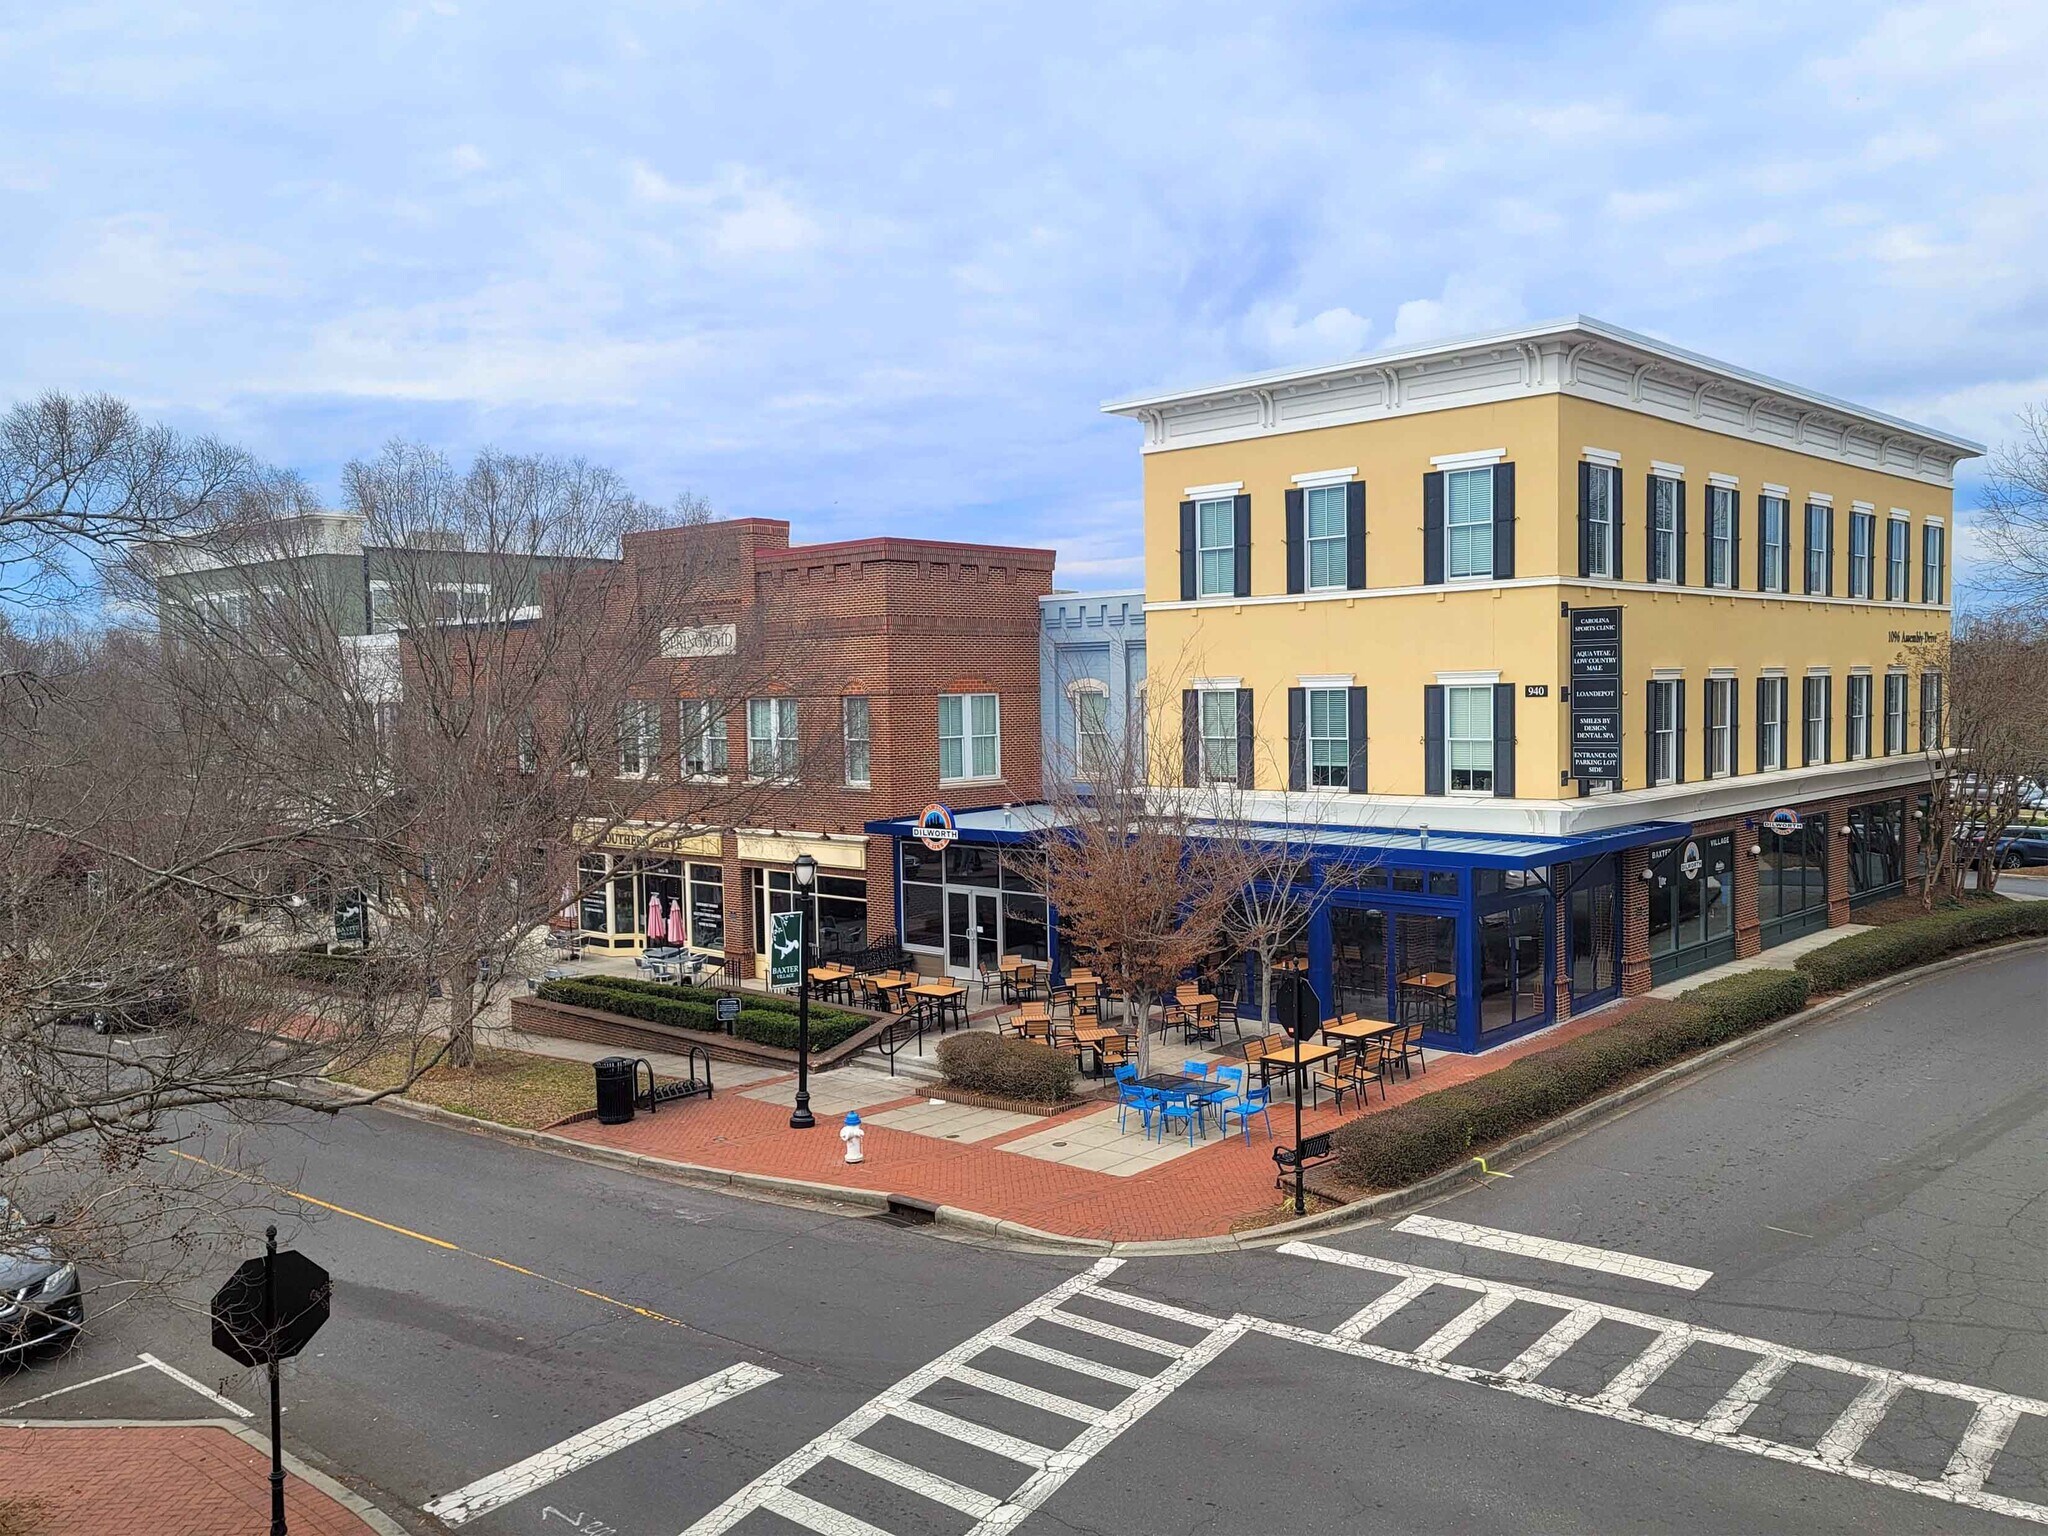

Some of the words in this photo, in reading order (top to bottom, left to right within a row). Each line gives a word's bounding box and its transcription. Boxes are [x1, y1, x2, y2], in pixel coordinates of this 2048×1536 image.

[1901, 630, 1924, 646] Assembly
[1528, 686, 1545, 696] 940
[913, 828, 957, 838] DILWORTH
[1710, 836, 1730, 847] VILLAGE
[772, 965, 799, 975] BAXTER
